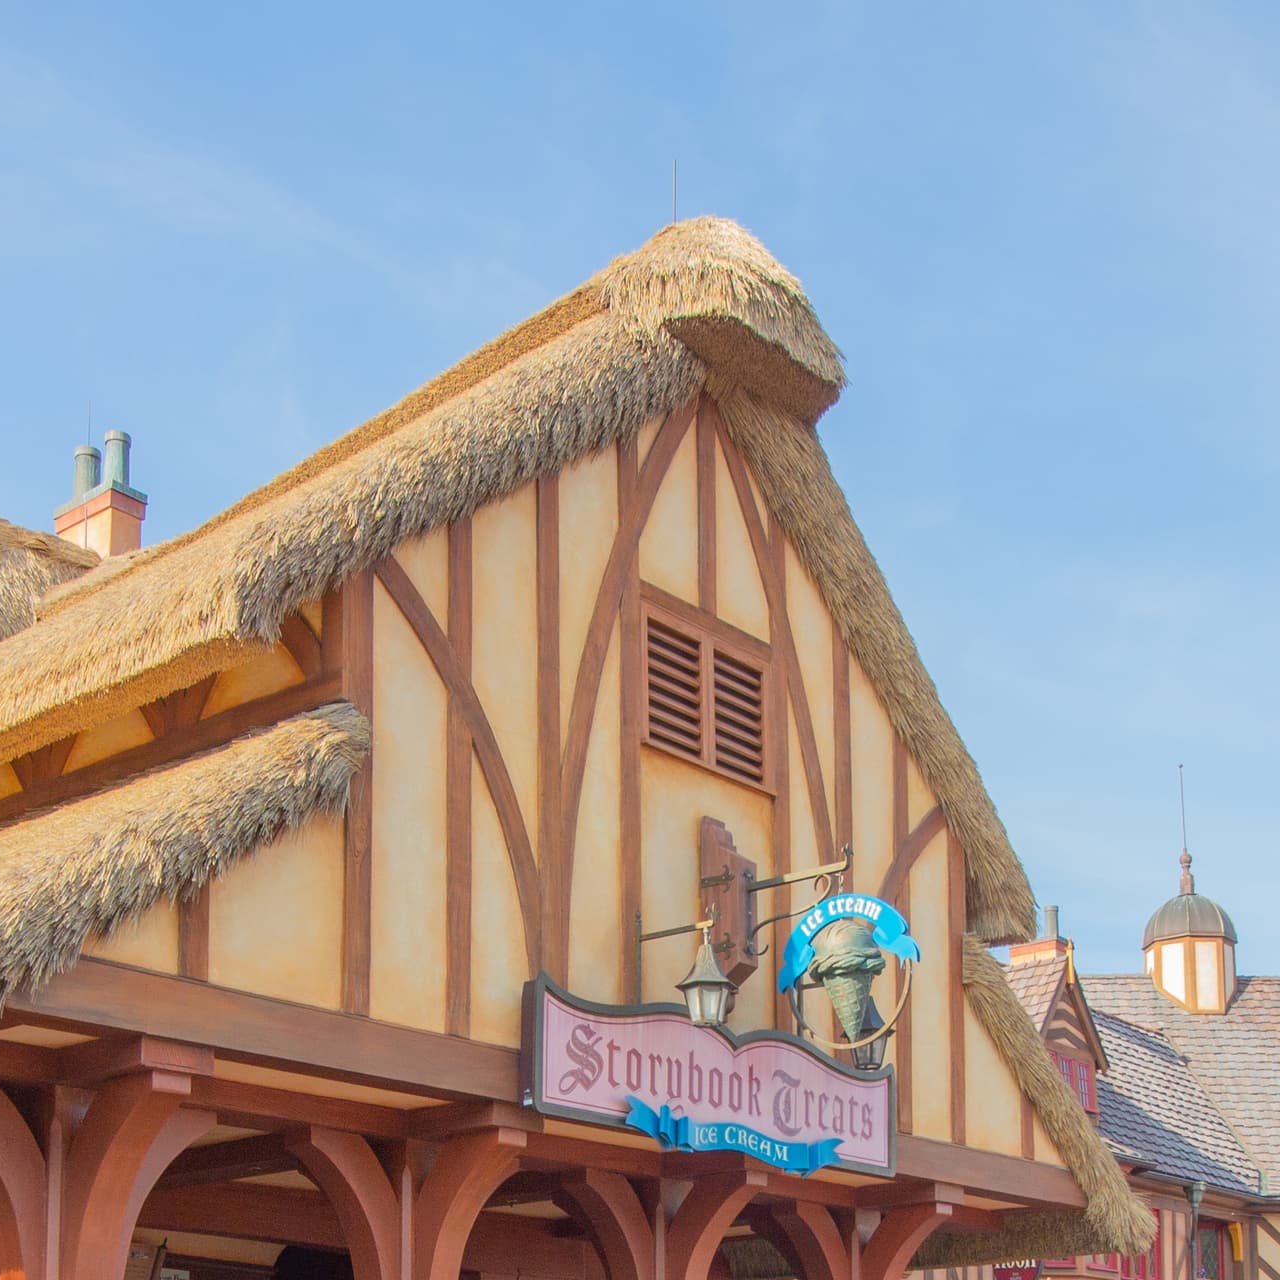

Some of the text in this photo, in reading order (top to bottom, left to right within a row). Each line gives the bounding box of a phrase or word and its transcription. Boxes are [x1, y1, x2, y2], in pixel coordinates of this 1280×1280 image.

[801, 896, 882, 937] ice cream
[558, 1023, 874, 1141] Storybook Treats
[695, 1126, 790, 1162] ICE CREAM
